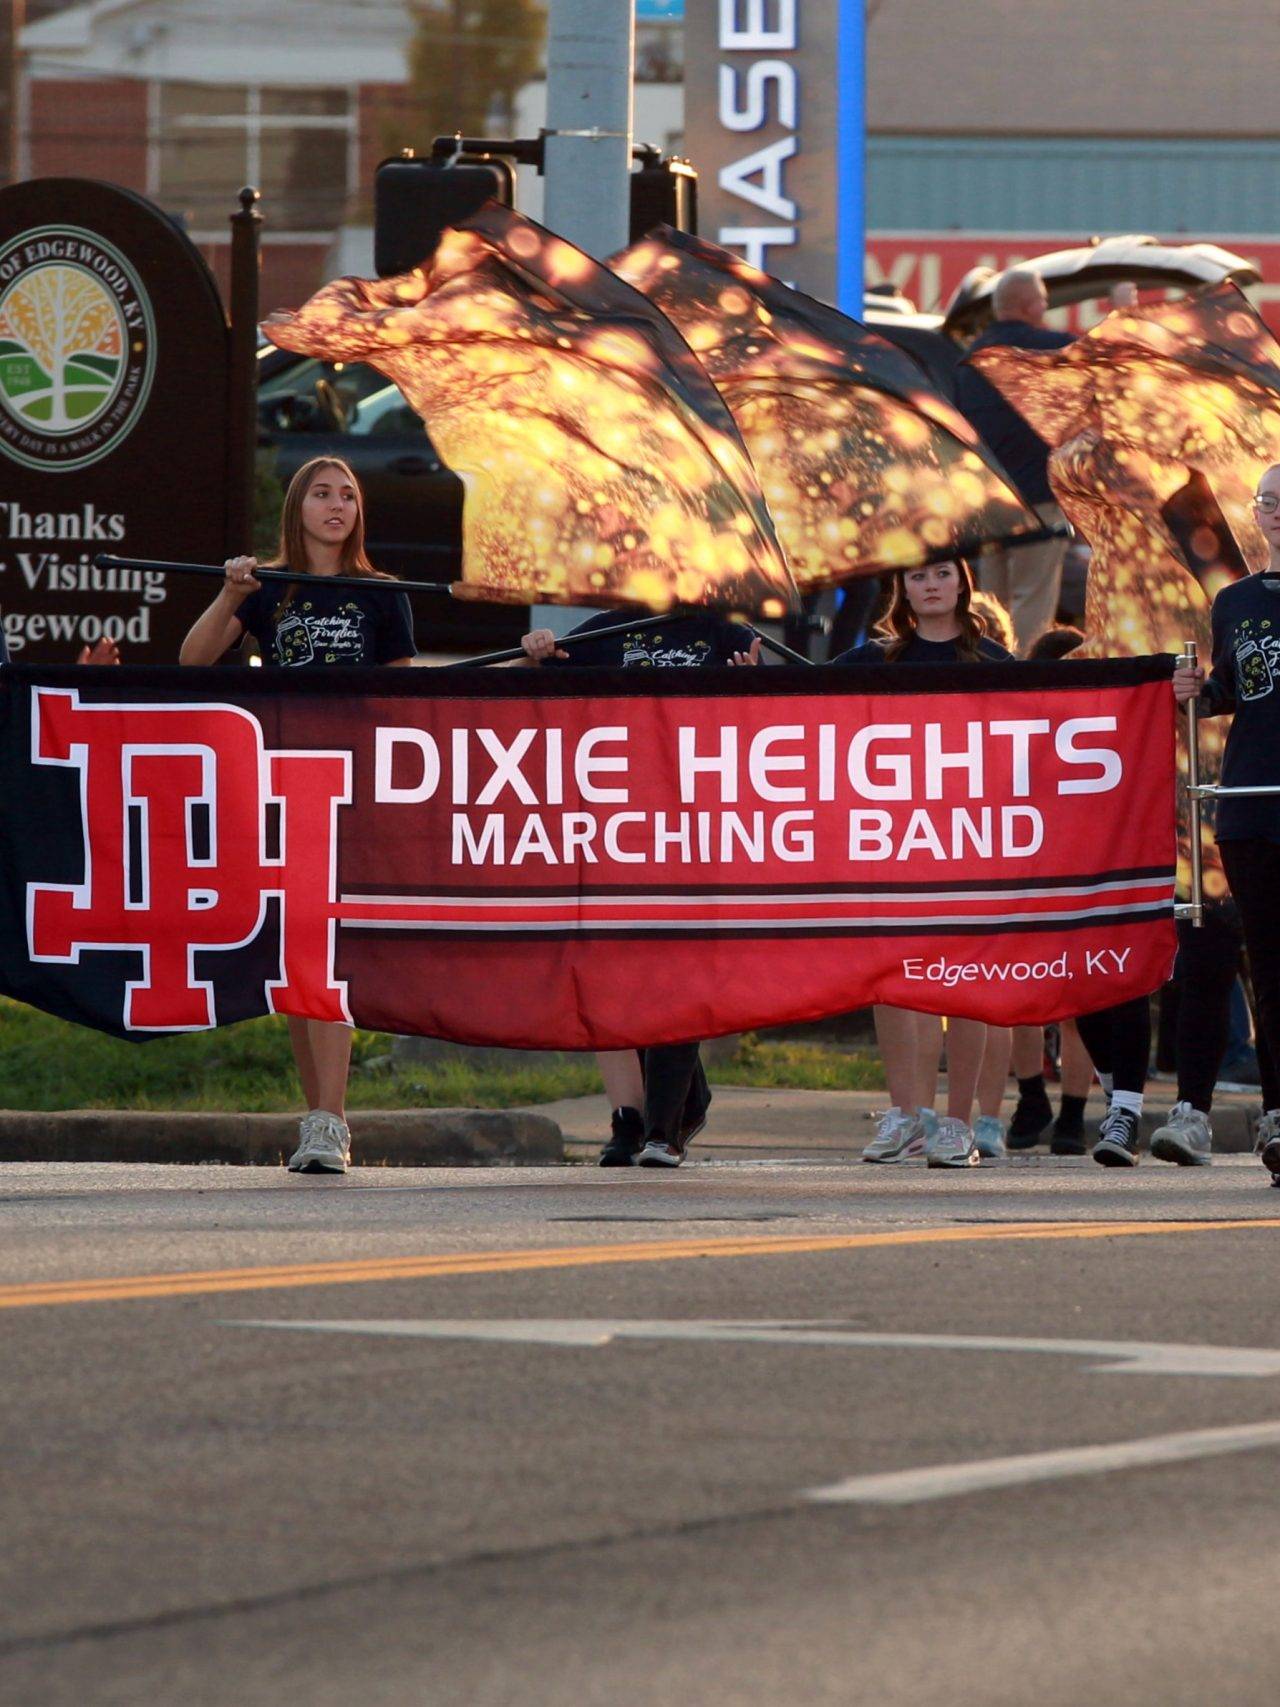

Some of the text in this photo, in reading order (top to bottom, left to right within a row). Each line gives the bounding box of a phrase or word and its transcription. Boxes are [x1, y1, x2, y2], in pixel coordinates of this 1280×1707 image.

[719, 0, 796, 290] HASE
[0, 240, 145, 330] OF EDGEWOOD, KY
[0, 501, 127, 541] hanks
[15, 552, 168, 604] Visiting
[3, 605, 151, 651] gewood
[374, 716, 1124, 806] DIXIE HEIGHTS
[450, 804, 1045, 866] MARCHING BAND
[902, 946, 1132, 988] Edgewood, KY
